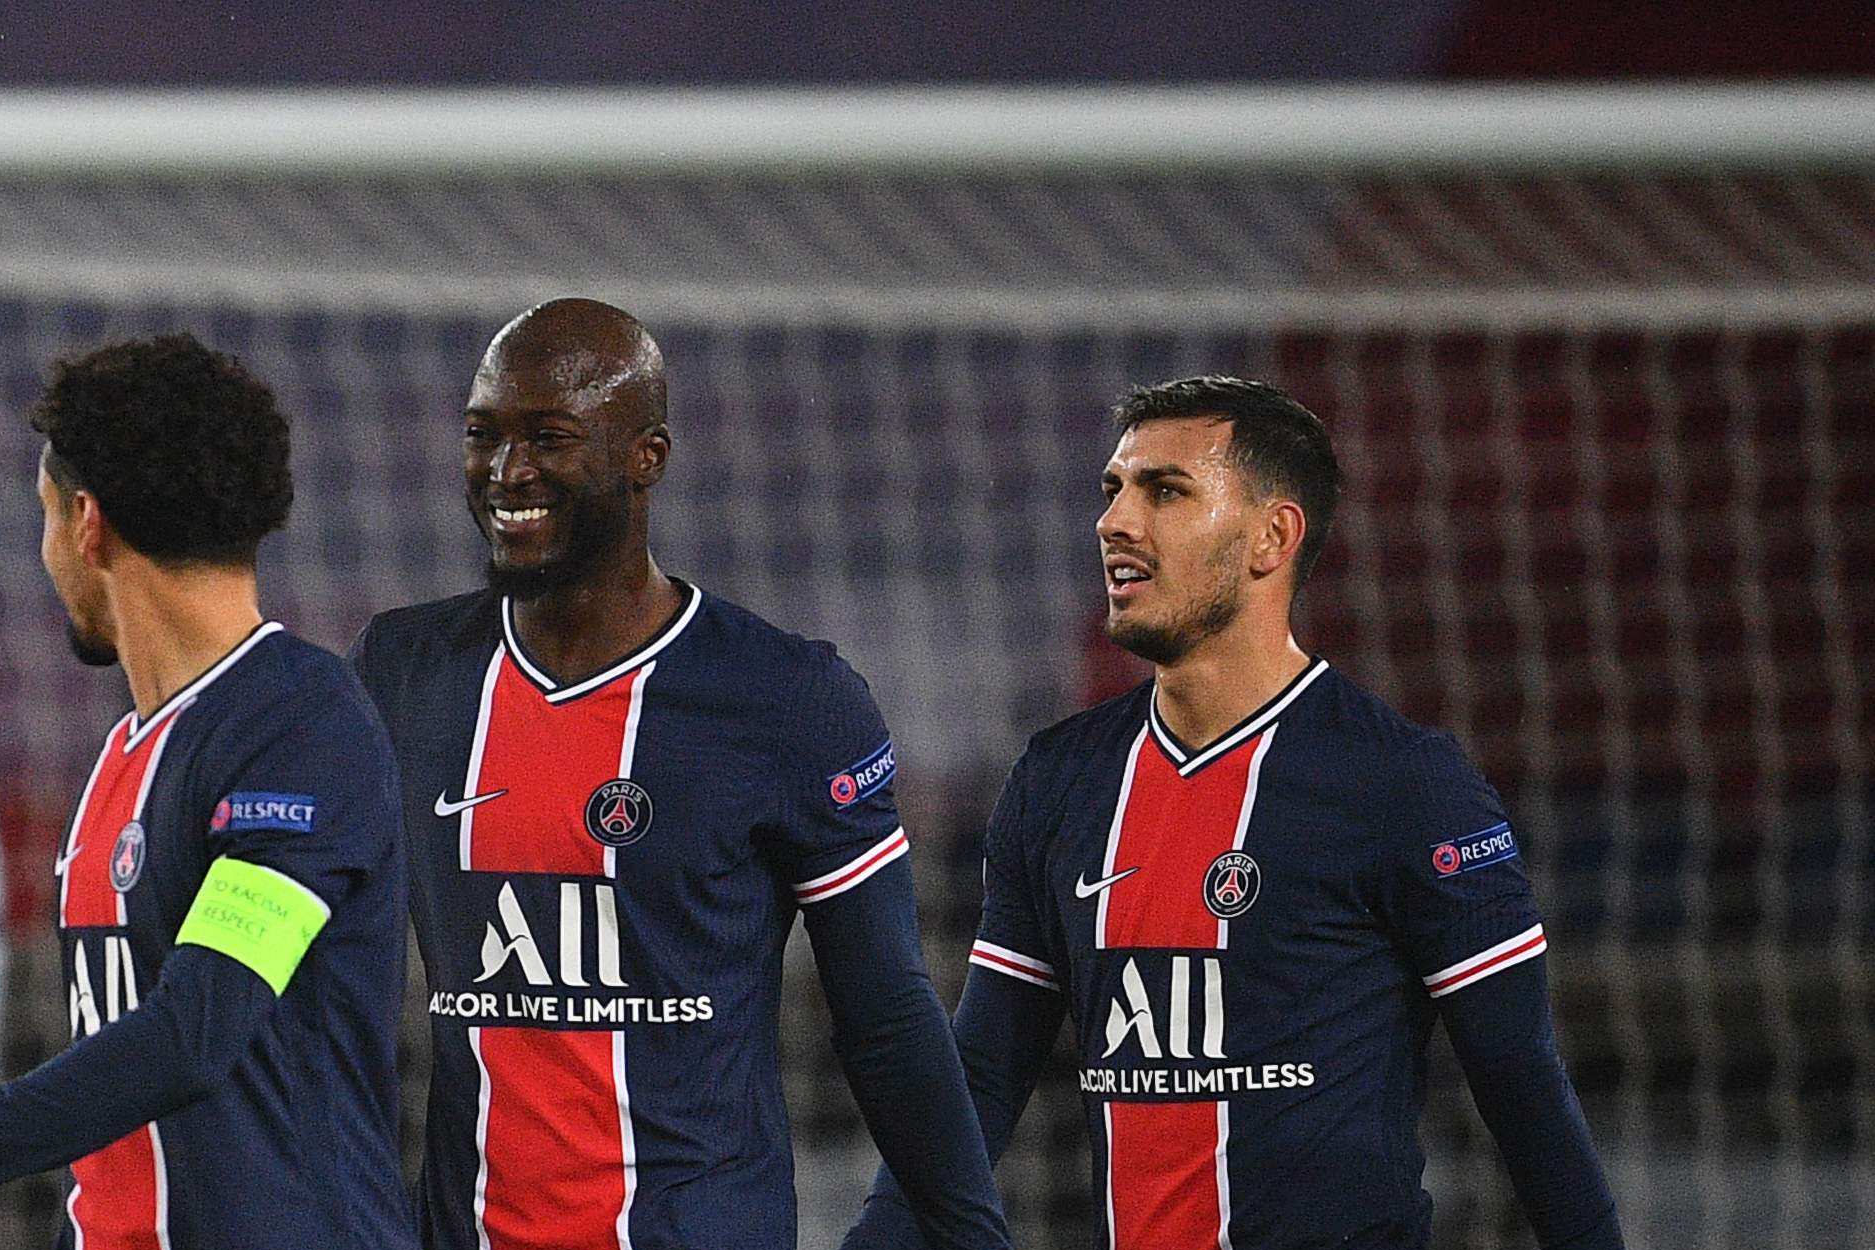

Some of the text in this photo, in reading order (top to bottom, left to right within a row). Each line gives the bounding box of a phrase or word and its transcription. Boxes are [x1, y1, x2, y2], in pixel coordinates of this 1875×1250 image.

[601, 784, 643, 803] PARIS
[231, 801, 316, 822] RESPECT
[1461, 831, 1514, 862] RESPECT
[1217, 856, 1254, 873] PARIS
[428, 991, 714, 1023] ACCOR LIVE LIMITLESS
[1120, 1069, 1170, 1094] LIVE
[1174, 1063, 1316, 1094] LIMITLESS
